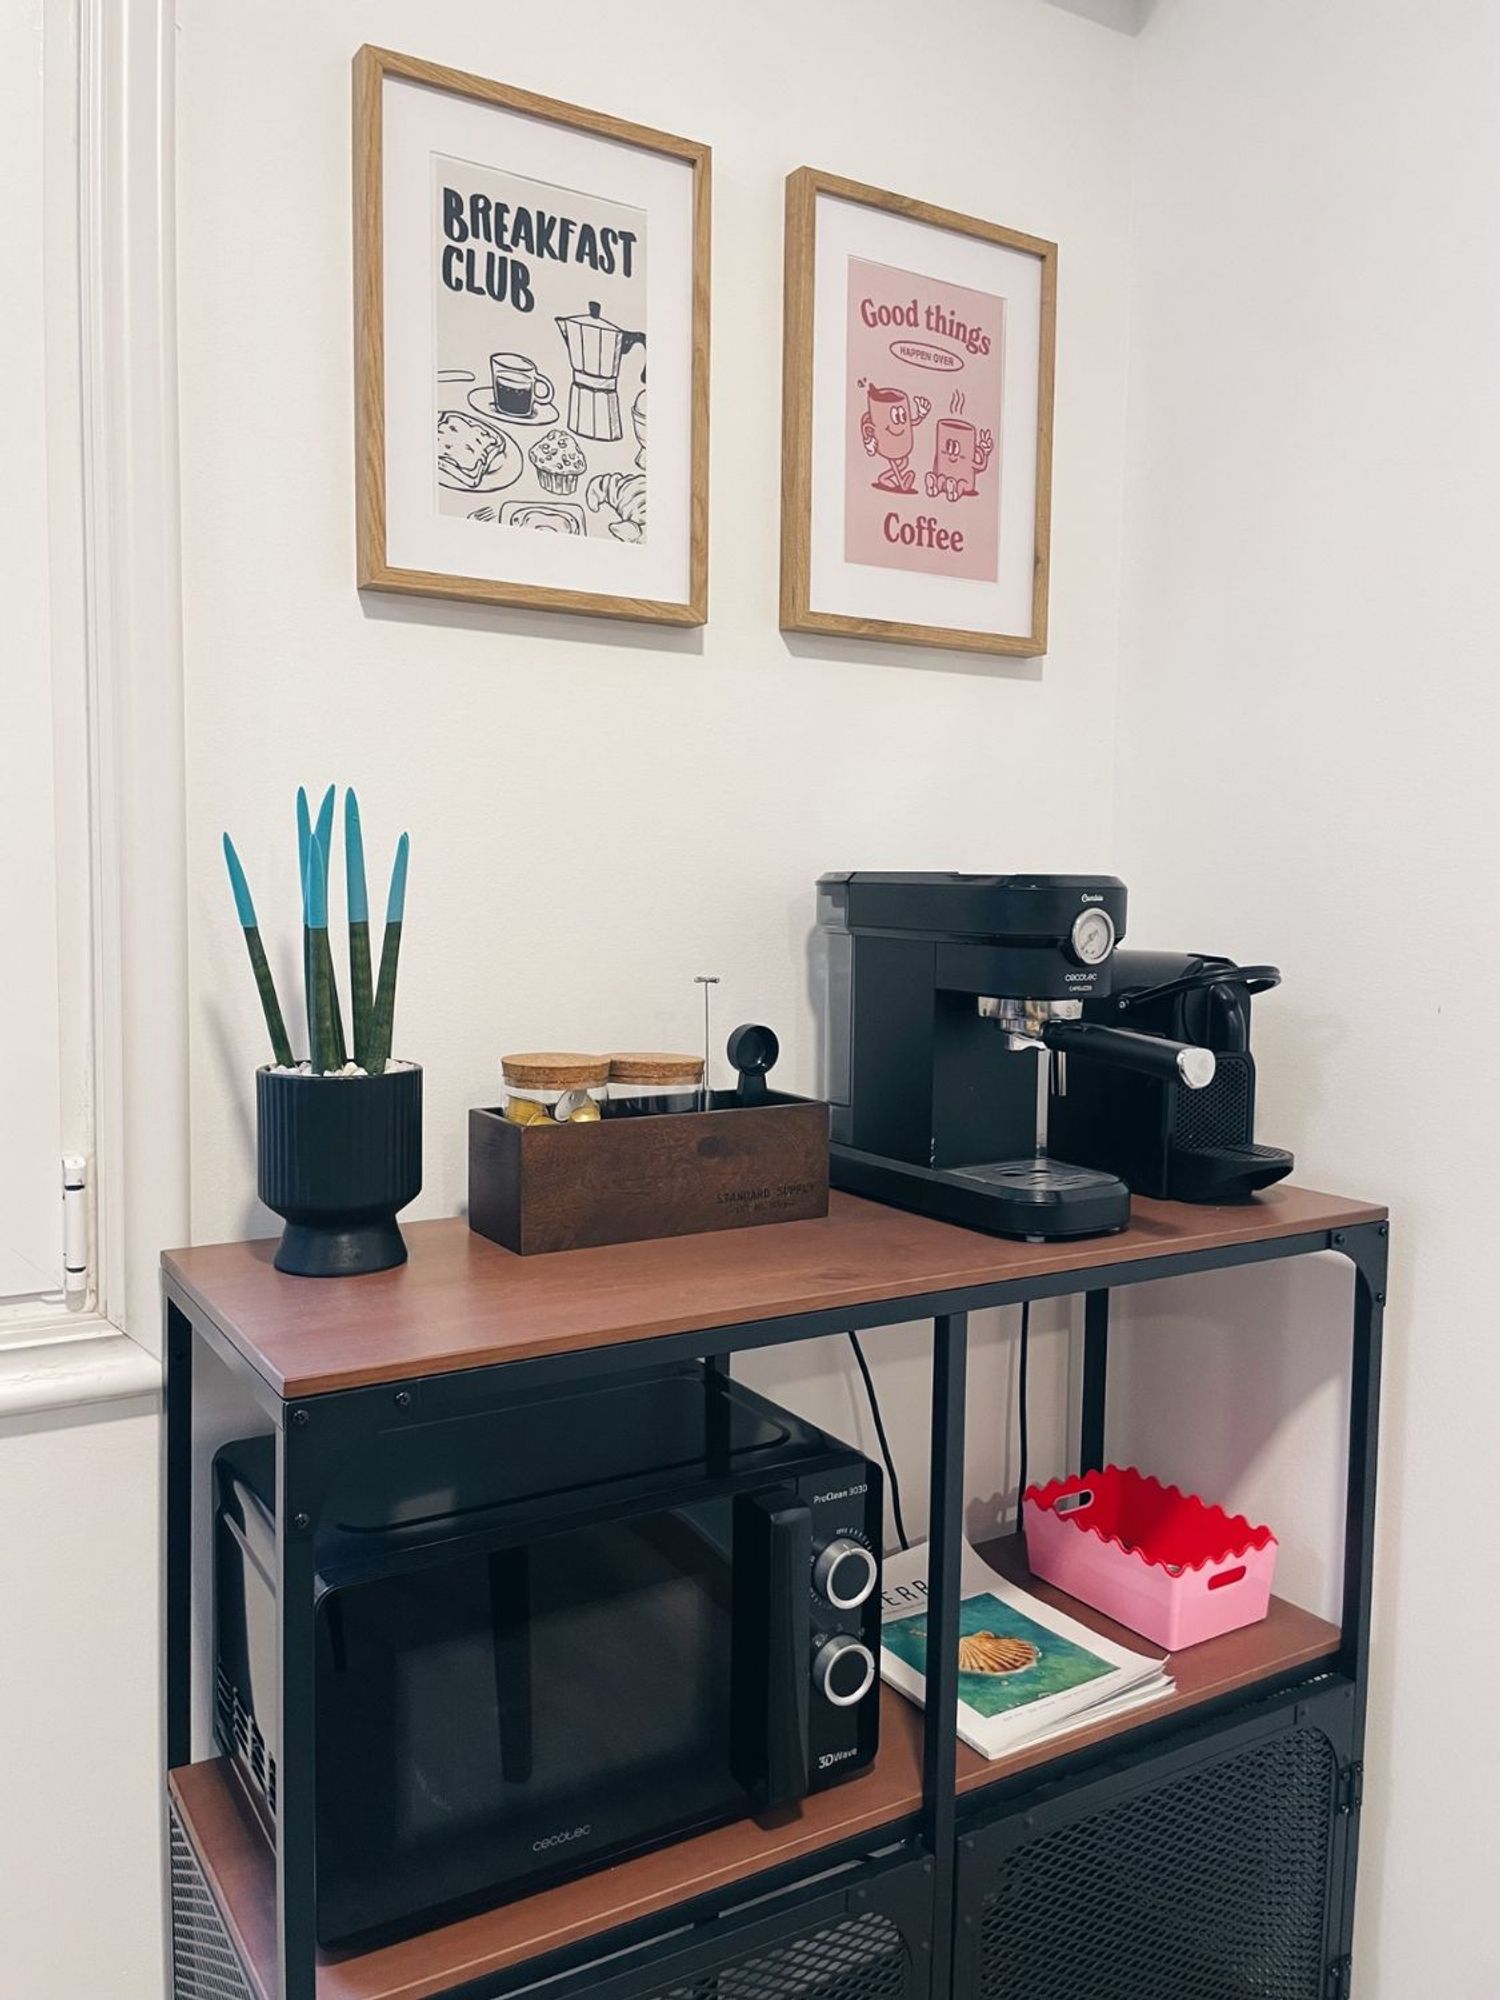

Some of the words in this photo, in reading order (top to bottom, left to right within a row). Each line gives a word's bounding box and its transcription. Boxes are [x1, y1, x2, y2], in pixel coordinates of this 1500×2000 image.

[443, 187, 636, 278] BREAKFAST
[442, 245, 534, 312] CLUB
[861, 298, 919, 328] Good
[925, 304, 991, 356] things
[900, 346, 931, 361] HAPPEN
[933, 353, 954, 366] OVER
[883, 511, 964, 552] Coffee
[813, 1490, 848, 1504] ProClean
[533, 1825, 591, 1851] cecotec
